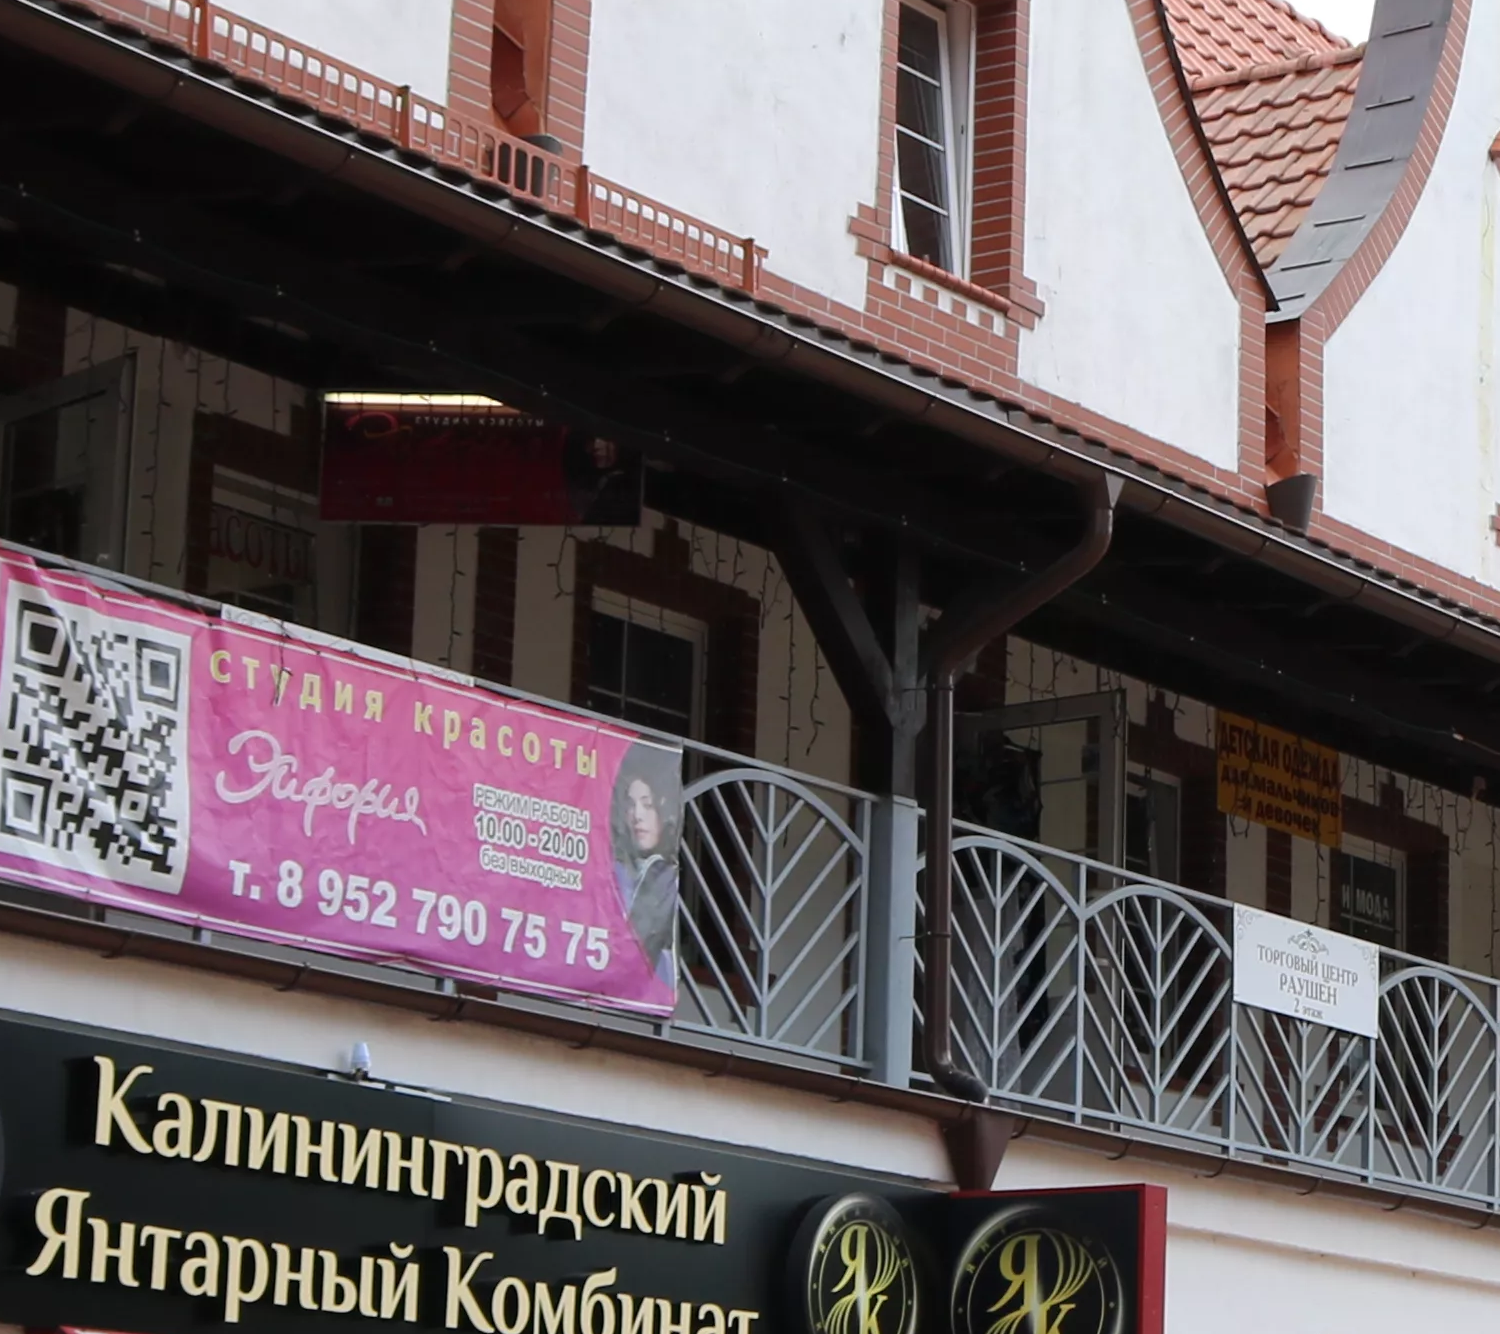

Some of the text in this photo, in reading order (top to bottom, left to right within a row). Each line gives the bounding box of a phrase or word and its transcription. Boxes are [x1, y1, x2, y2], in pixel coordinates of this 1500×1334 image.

[413, 700, 598, 778] красоты
[474, 783, 591, 834] РЕЖИМ РАБОТЫ
[474, 814, 526, 848] 10.00
[540, 829, 589, 863] 20.00
[480, 846, 583, 890] без выходных
[227, 859, 611, 971] т. 8 952 790 75 75
[1256, 943, 1319, 978] ТОРГОВЫЙ
[1321, 962, 1359, 987] ЦЕНТР
[1279, 972, 1338, 1006] РАУШЕН
[1293, 997, 1300, 1014] 2
[92, 1055, 728, 1246] Калининградский
[25, 1186, 420, 1324] Янтарный
